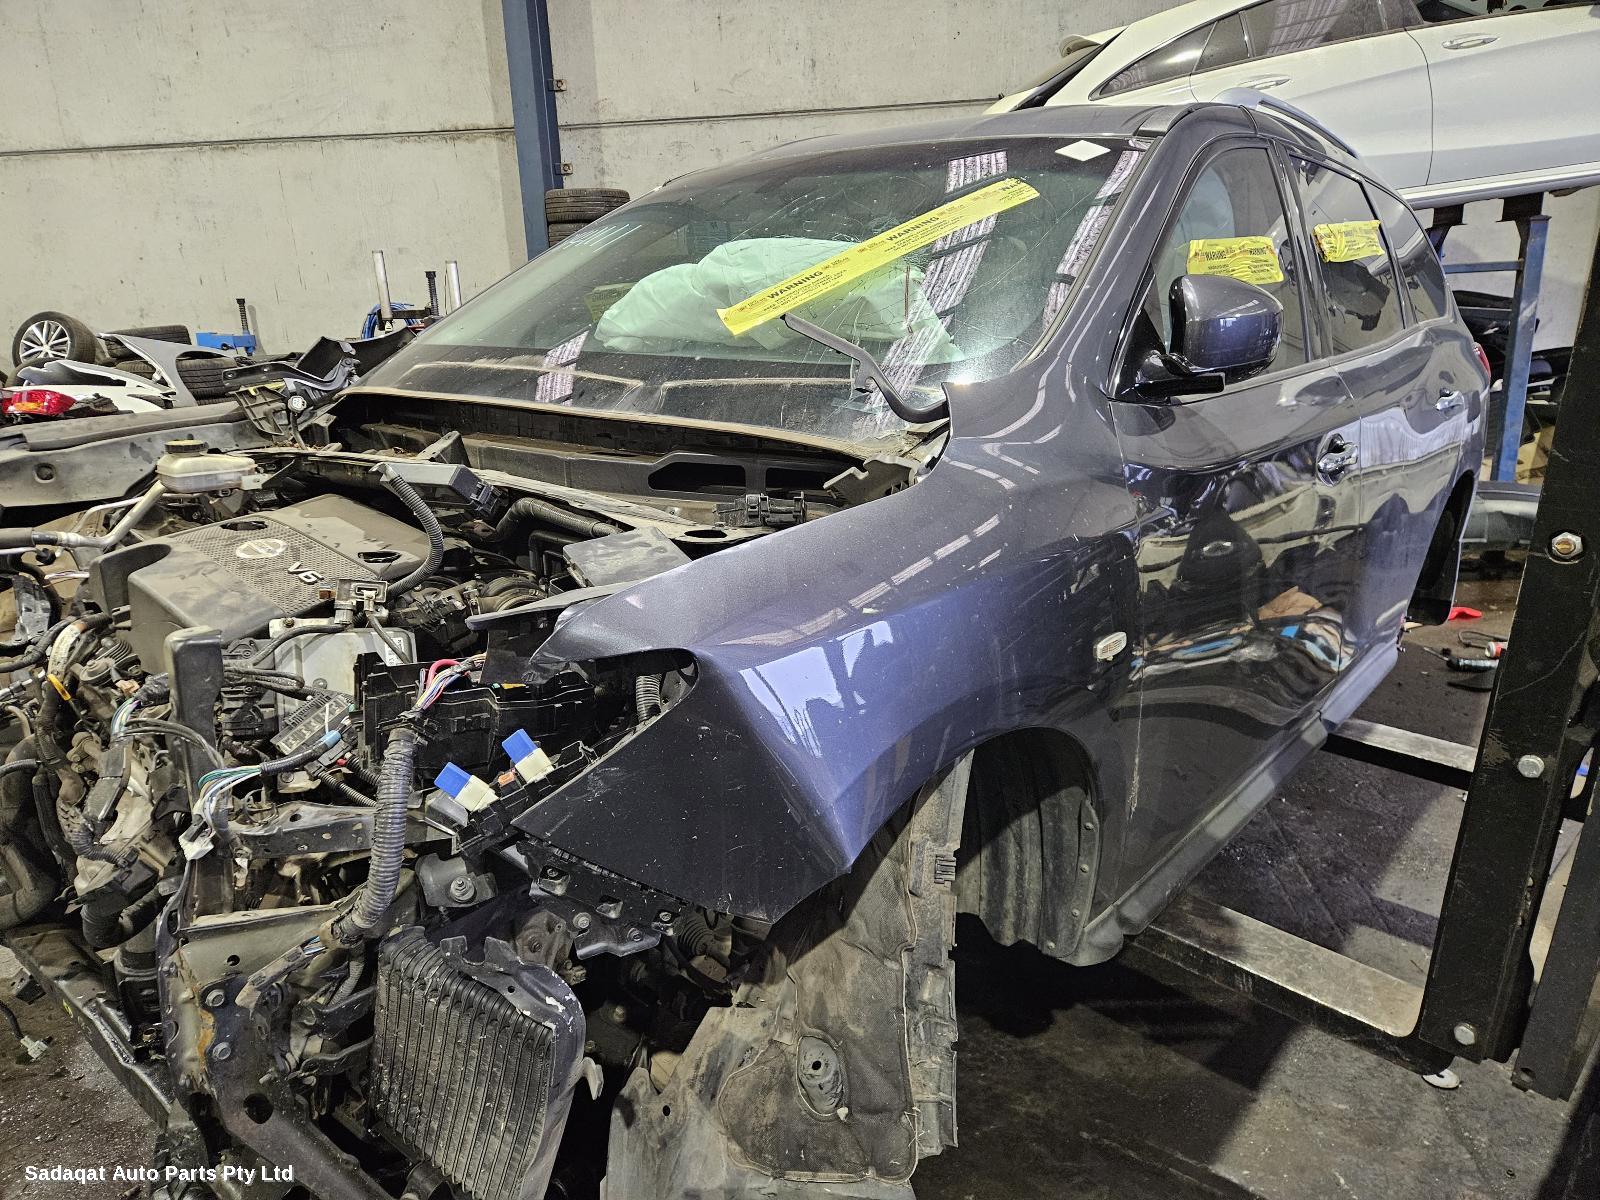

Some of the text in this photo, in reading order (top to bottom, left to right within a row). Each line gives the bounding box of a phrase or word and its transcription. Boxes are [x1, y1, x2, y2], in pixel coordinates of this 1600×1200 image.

[886, 216, 940, 241] WARNING
[767, 270, 824, 300] WARNING
[287, 561, 325, 585] V6
